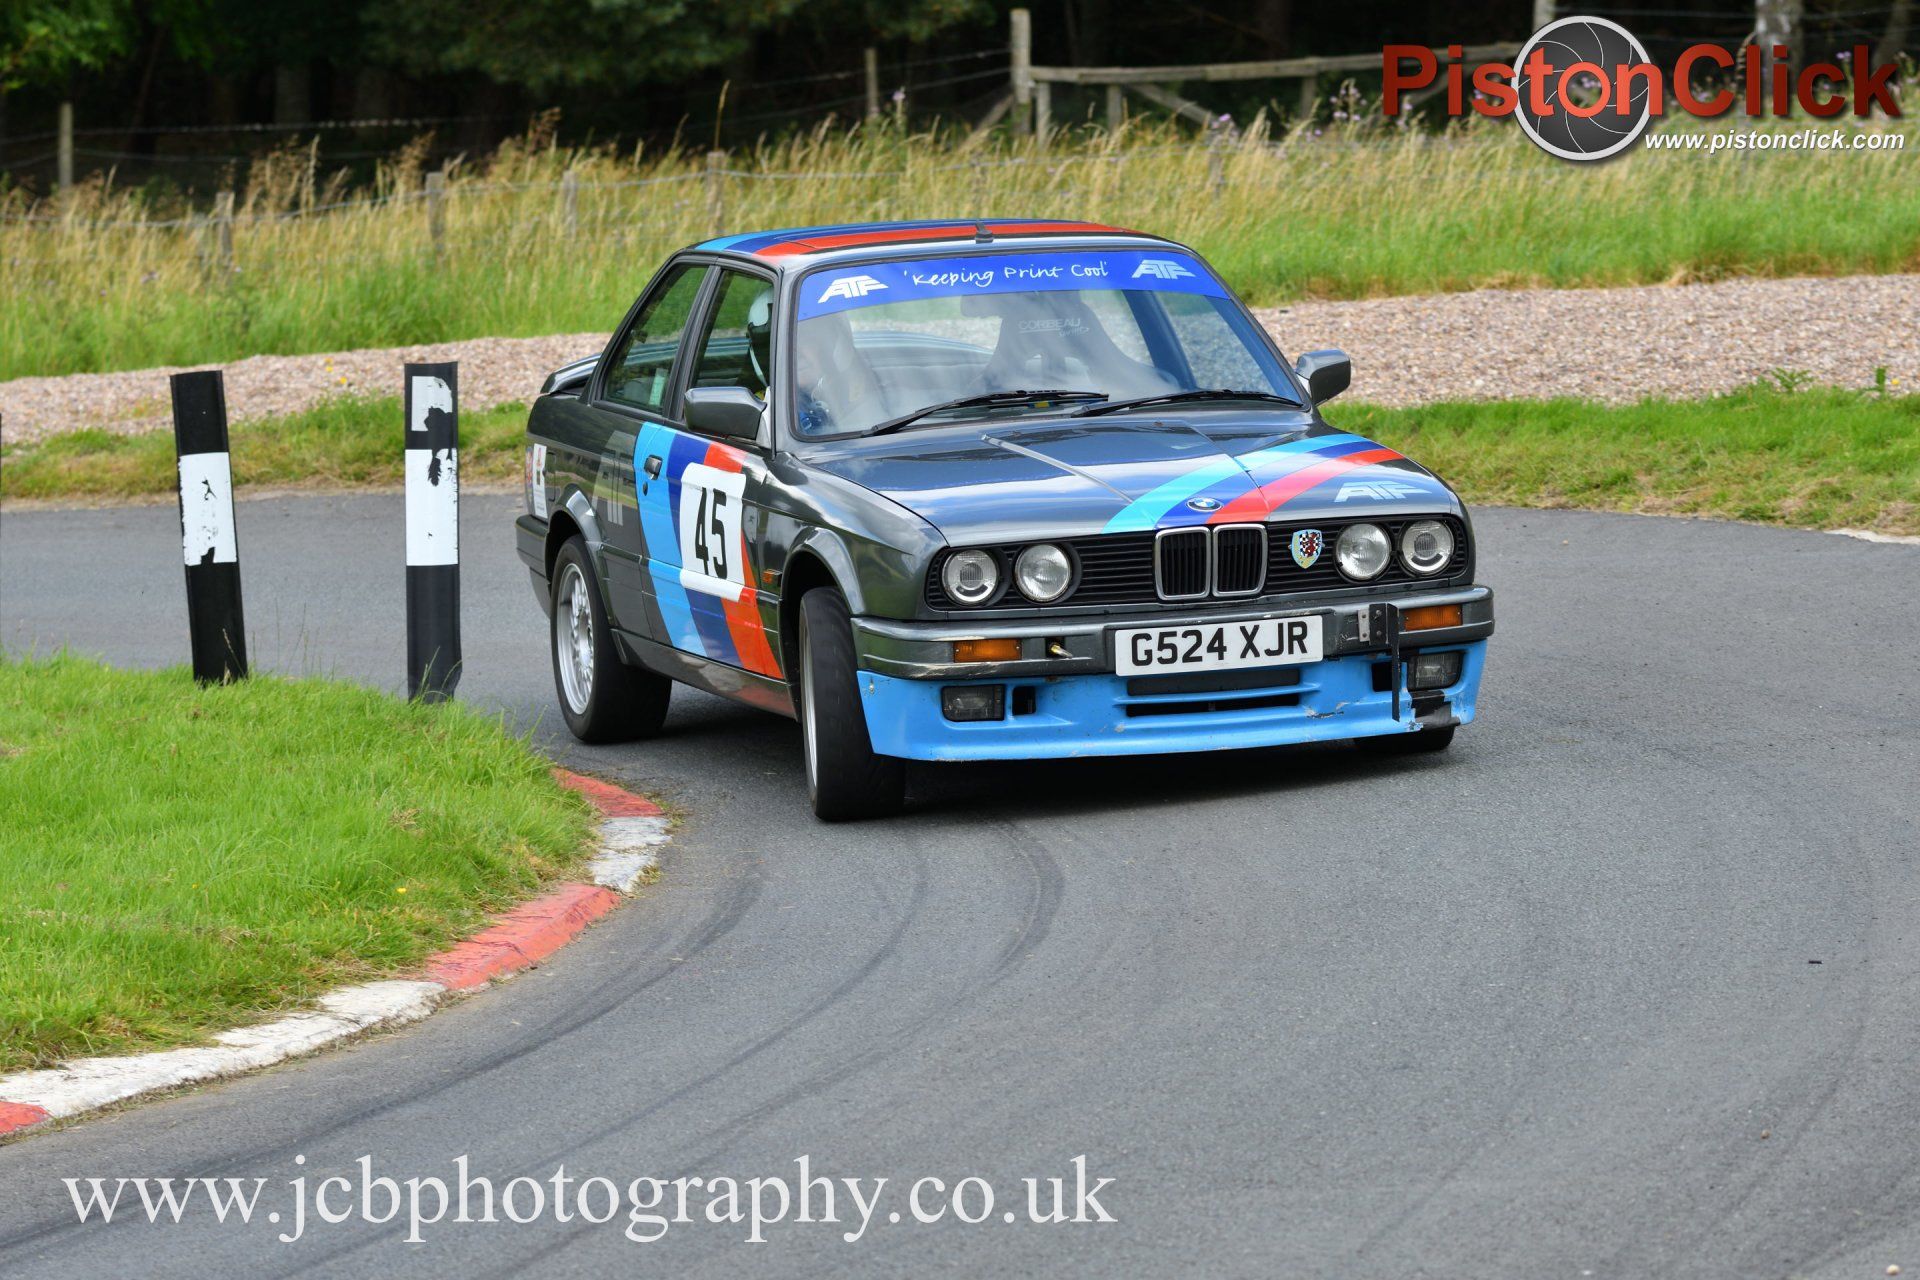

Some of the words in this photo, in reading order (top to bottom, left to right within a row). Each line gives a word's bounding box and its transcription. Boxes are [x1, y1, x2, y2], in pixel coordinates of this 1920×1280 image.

[1131, 259, 1197, 280] ATF
[817, 275, 889, 304] ATF
[1334, 481, 1432, 503] ATF
[694, 487, 728, 580] 45
[1130, 627, 1227, 668] G524
[1239, 620, 1309, 659] XJR
